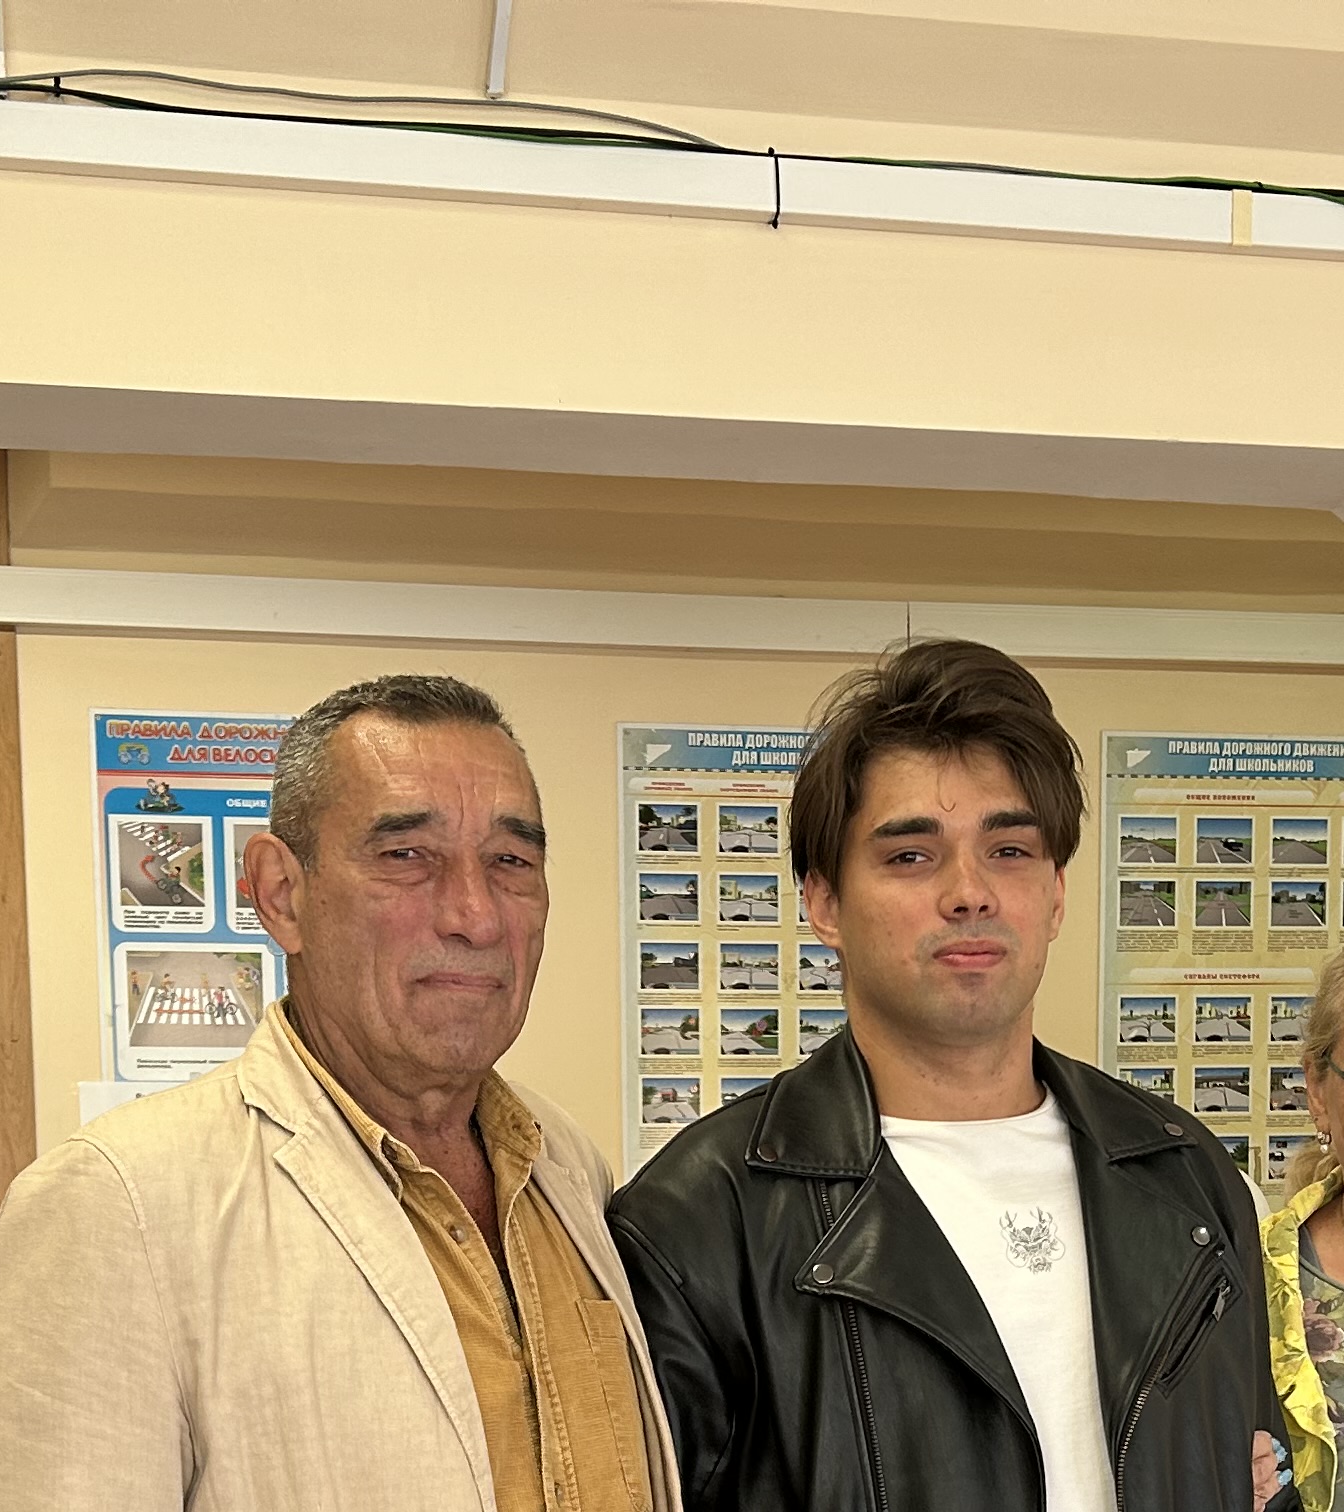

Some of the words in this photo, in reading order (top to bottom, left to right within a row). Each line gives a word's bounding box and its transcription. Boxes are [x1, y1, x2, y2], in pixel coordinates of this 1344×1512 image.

[108, 720, 192, 738] ПРАВИЛА
[688, 732, 743, 747] ПРАВИЛА
[169, 747, 207, 763] ДЛЯ
[1168, 741, 1220, 755] ПРАВИЛА
[1222, 742, 1291, 756] ДОРОЖНОГО
[731, 751, 757, 766] ДЛЯ
[1209, 758, 1234, 772] ДЛЯ
[1235, 759, 1314, 773] ШКОЛЬНИКОВ
